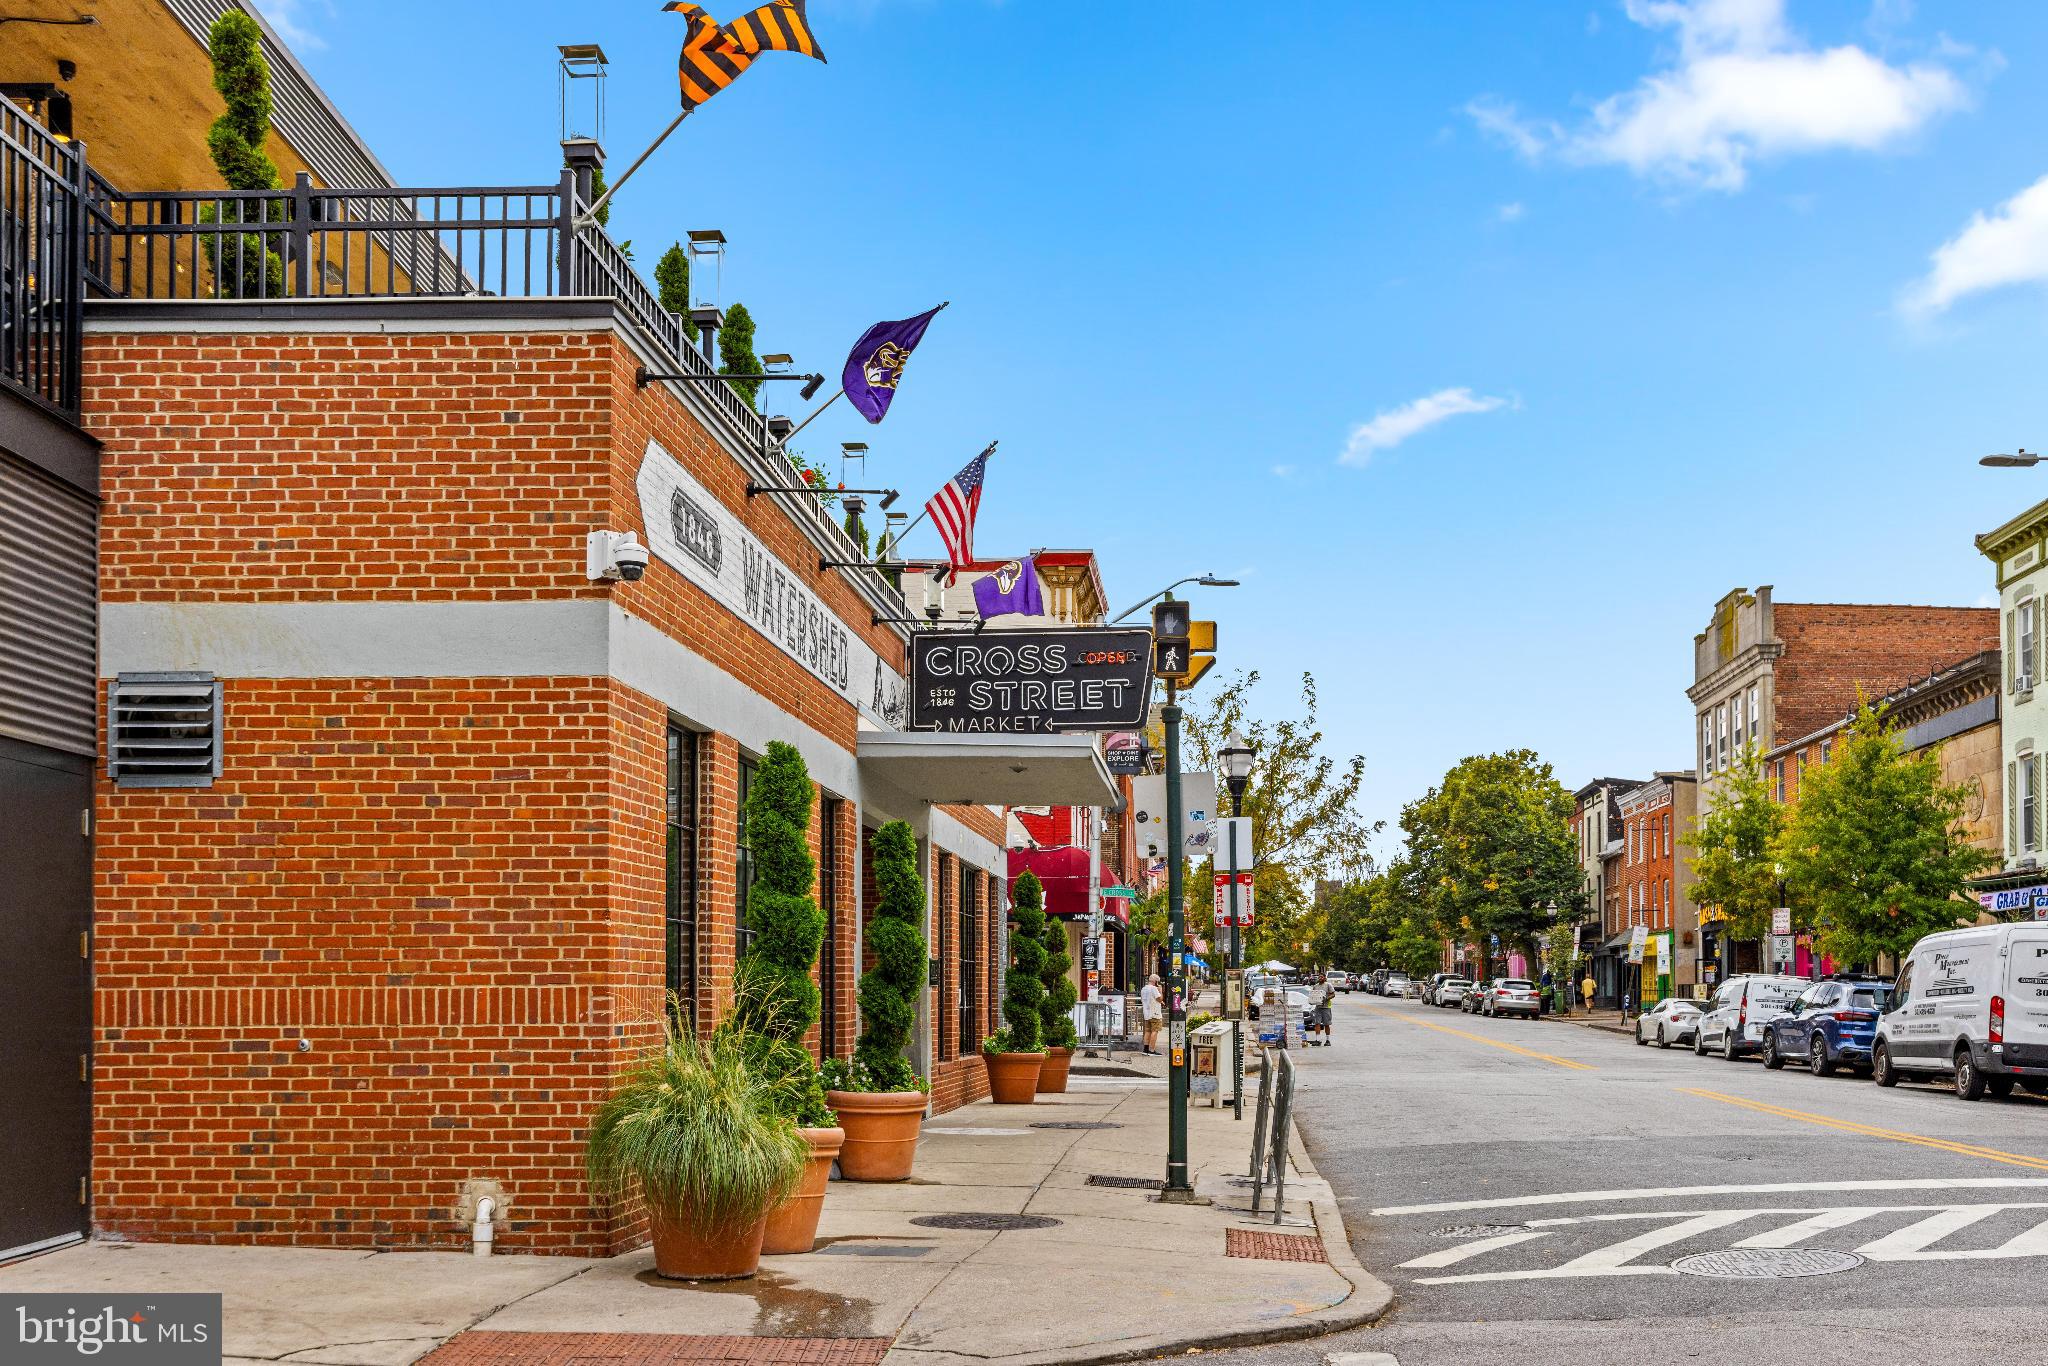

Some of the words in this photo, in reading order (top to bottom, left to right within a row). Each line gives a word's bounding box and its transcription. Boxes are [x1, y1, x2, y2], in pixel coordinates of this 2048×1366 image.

[680, 507, 714, 560] 1846
[741, 536, 849, 691] WATERSHED
[925, 644, 1068, 676] CROSS
[930, 689, 956, 697] ESTD
[930, 698, 955, 707] 1846
[968, 679, 1130, 711] STREET
[949, 715, 1040, 732] MARKET
[1996, 891, 2020, 910] GRAB
[1198, 1035, 1214, 1045] FREE
